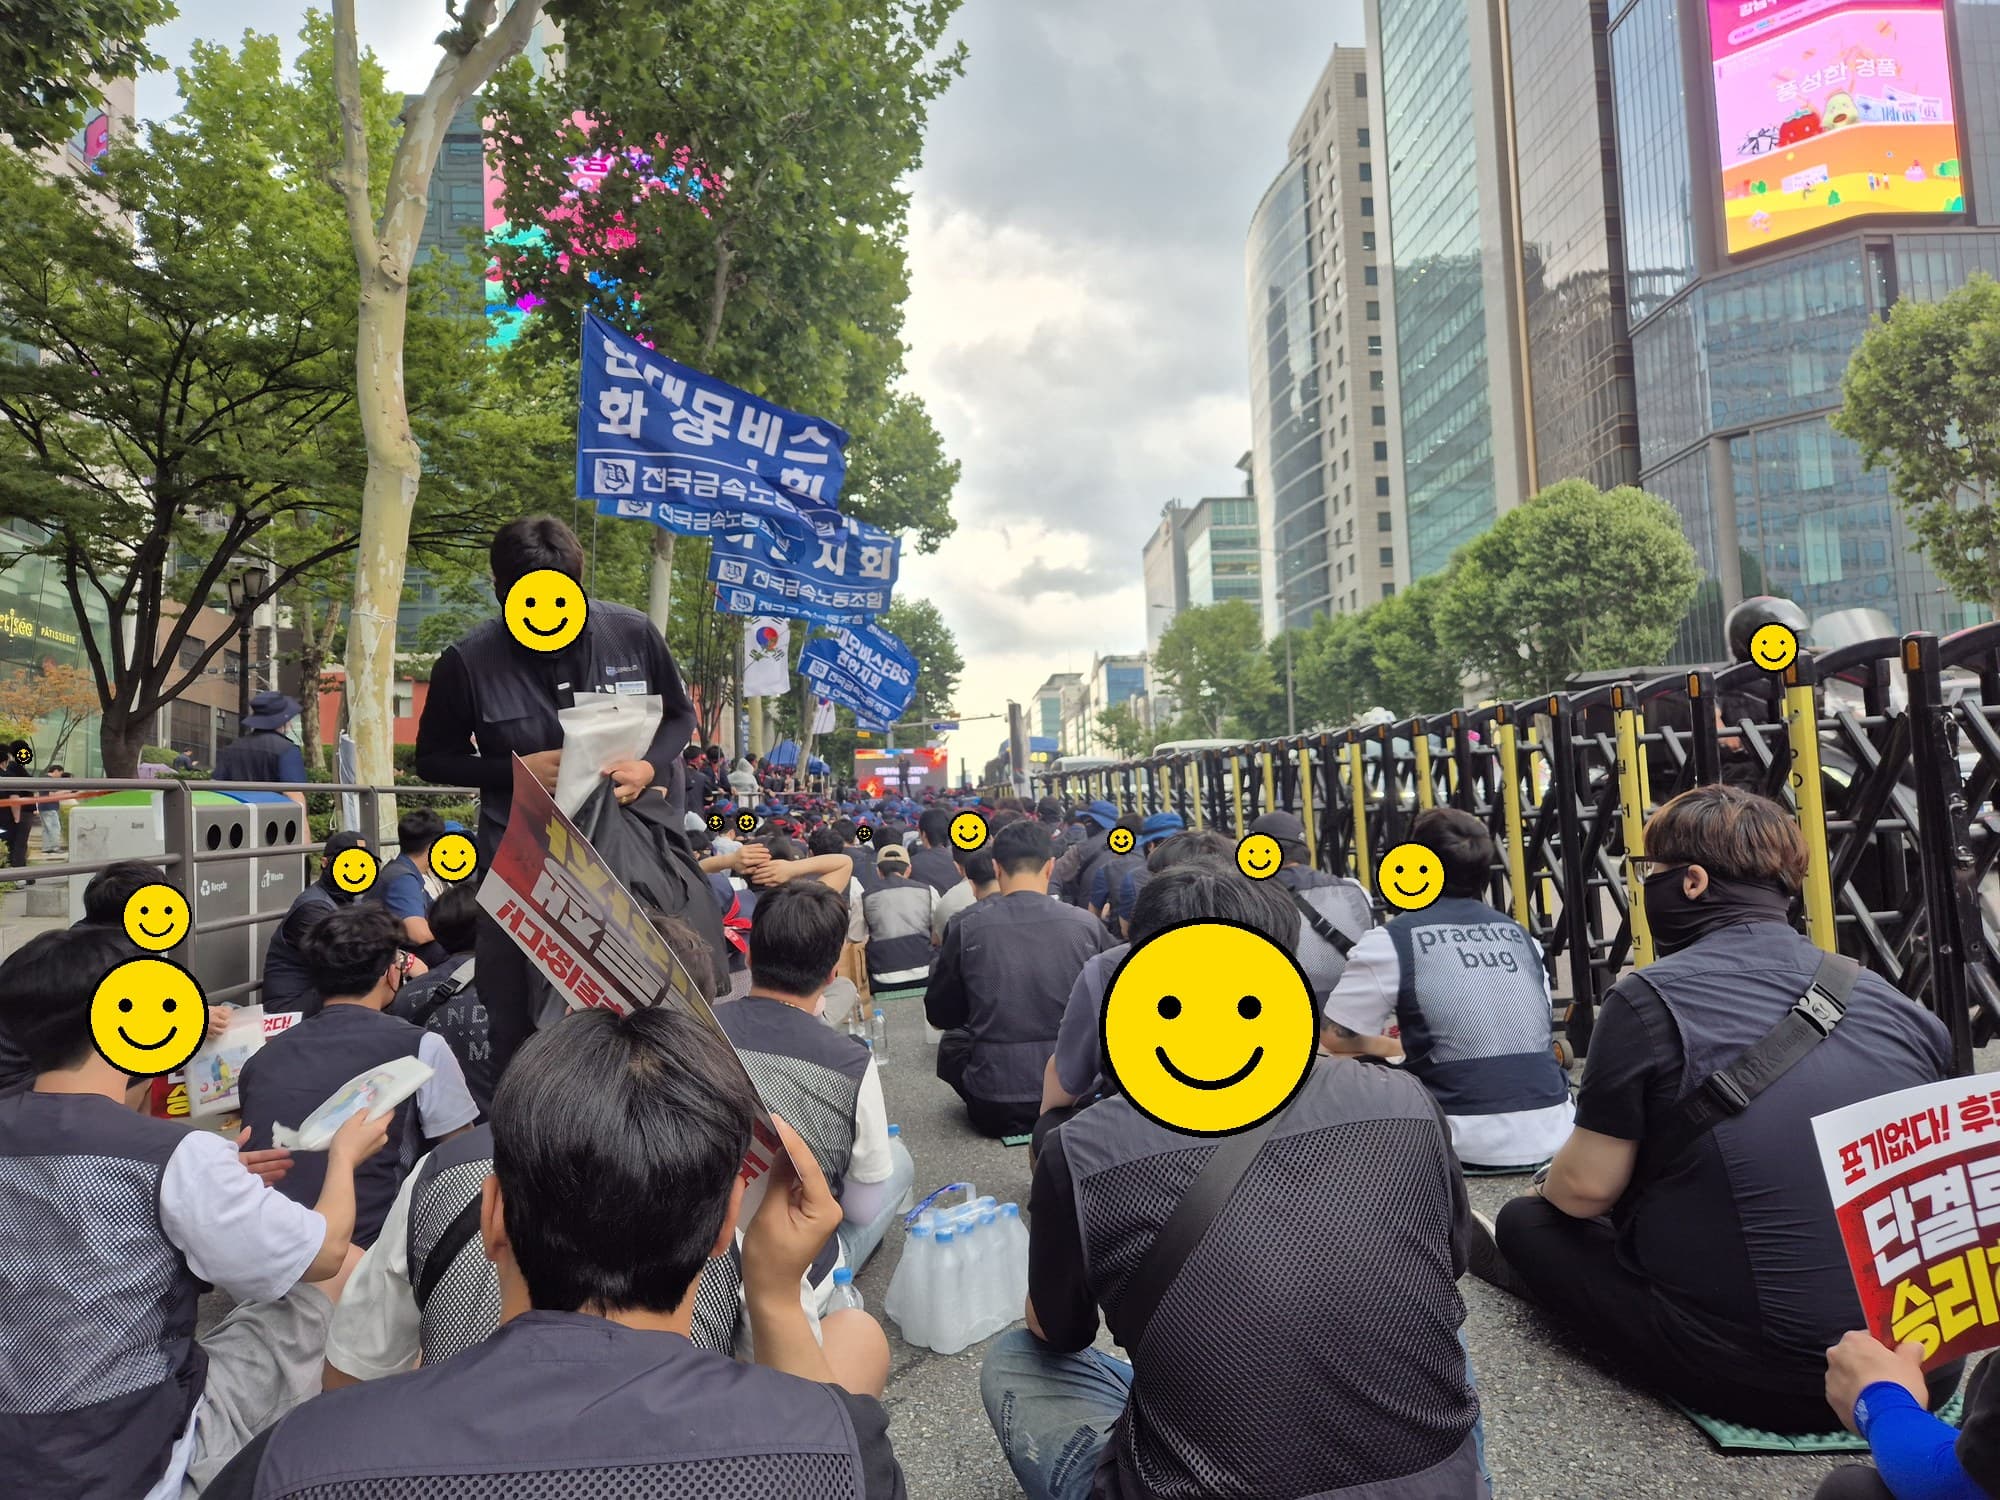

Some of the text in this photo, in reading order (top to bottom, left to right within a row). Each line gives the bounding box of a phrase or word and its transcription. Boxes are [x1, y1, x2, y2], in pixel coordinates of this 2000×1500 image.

[1775, 57, 1897, 102] 풍성한 경품
[753, 569, 883, 609] 전국금속노동조합
[1415, 926, 1523, 954] practice
[1456, 947, 1518, 973] bug
[1838, 1104, 1950, 1186] 포기없다!
[1891, 1238, 2000, 1362] 승리
